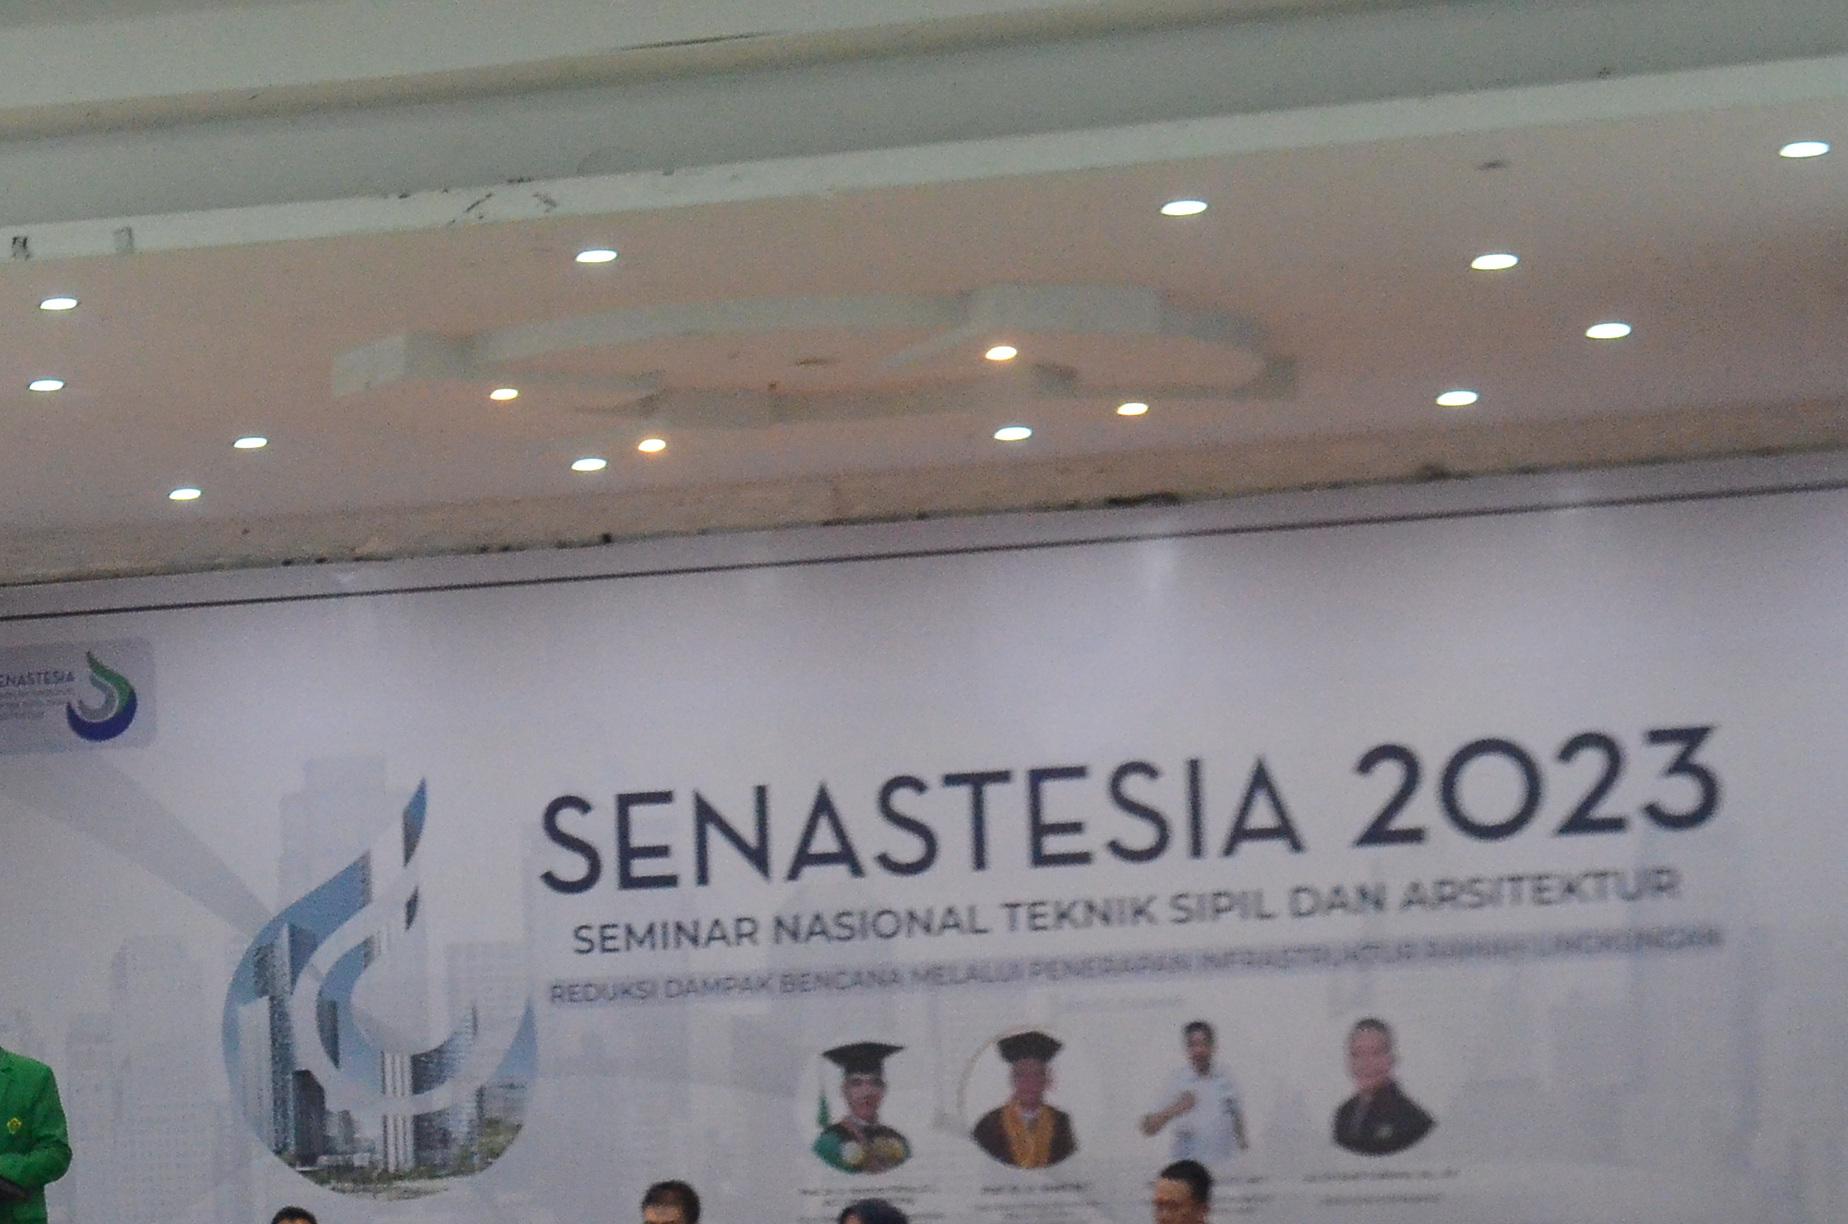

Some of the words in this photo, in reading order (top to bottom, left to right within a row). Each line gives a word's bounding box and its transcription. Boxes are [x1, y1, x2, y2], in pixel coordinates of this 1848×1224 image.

[539, 755, 1306, 895] SENASTESIA
[1353, 725, 1722, 847] 2023
[573, 914, 759, 955] SEMINAR
[773, 902, 991, 945] NASIONAL
[999, 895, 1158, 934] TEKNIK
[1169, 887, 1277, 925] SIPIL
[1288, 880, 1387, 919] DAN
[1399, 866, 1683, 911] ARSITEKTUR
[550, 977, 656, 1004] REDUKSI
[664, 972, 768, 1000] DAMPAK
[779, 967, 900, 994] BENCANA
